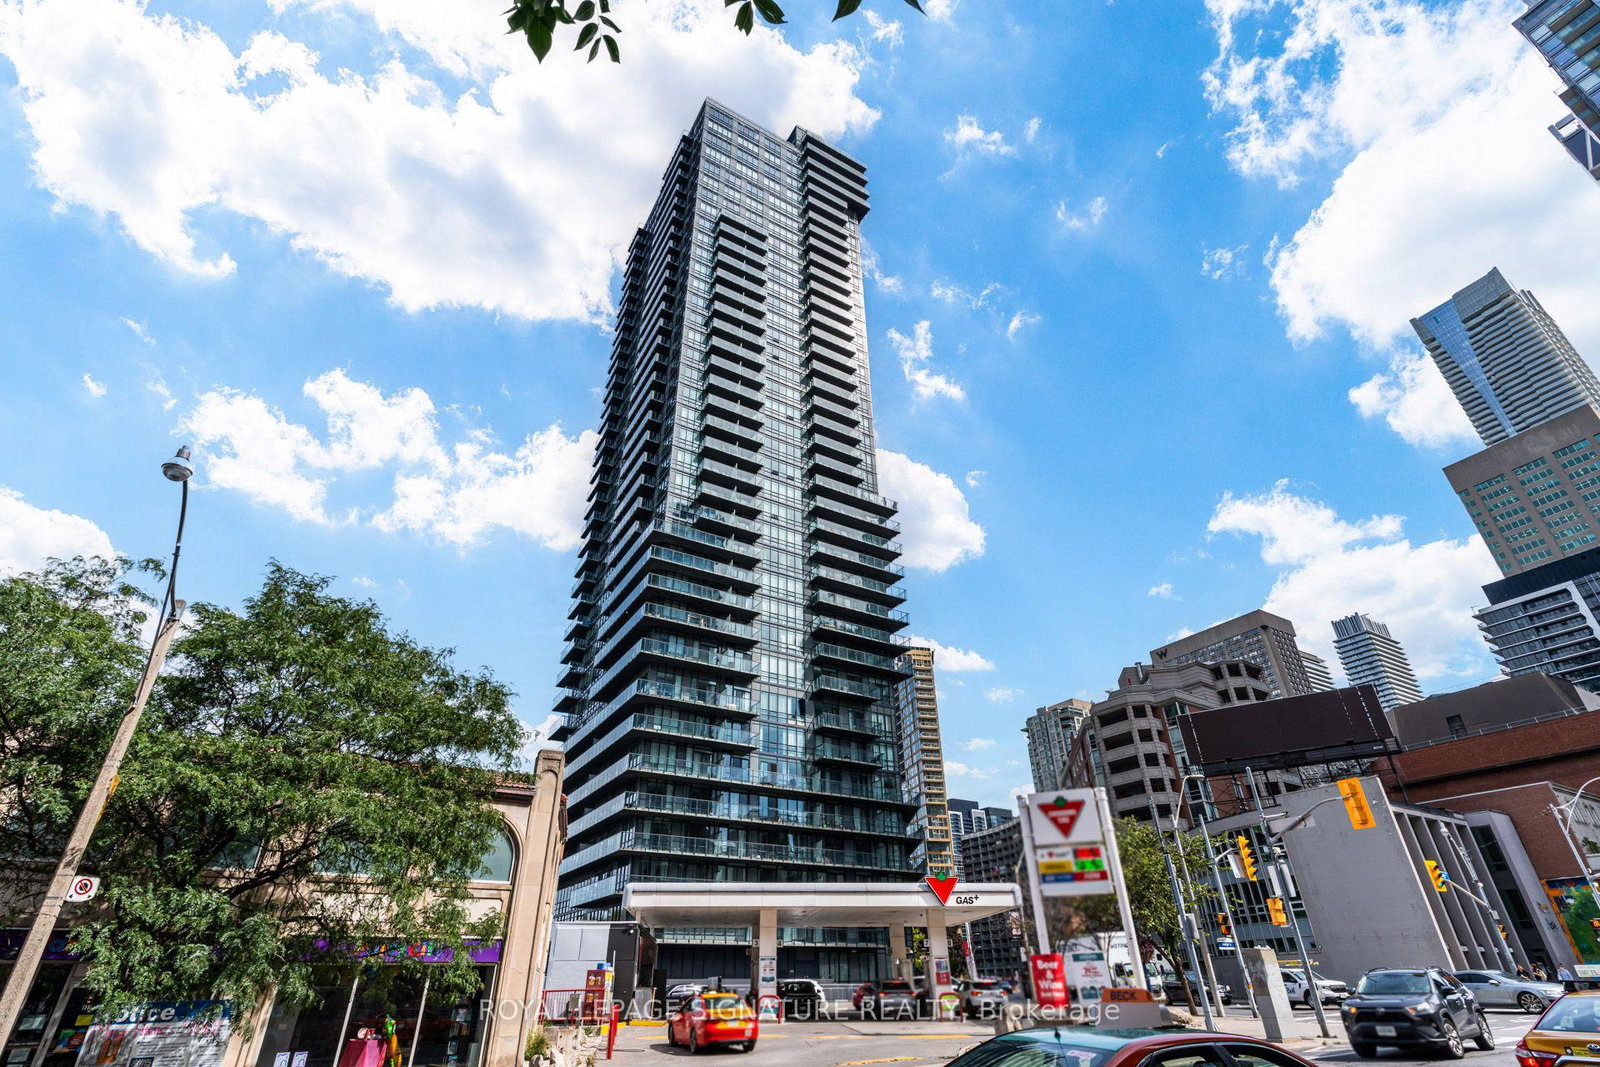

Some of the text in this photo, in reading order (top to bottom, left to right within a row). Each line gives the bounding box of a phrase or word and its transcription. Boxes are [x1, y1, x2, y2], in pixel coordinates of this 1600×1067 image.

[1156, 648, 1167, 659] W
[1036, 960, 1058, 969] Beer
[1038, 979, 1063, 989] Wine
[1110, 991, 1137, 1001] BECK
